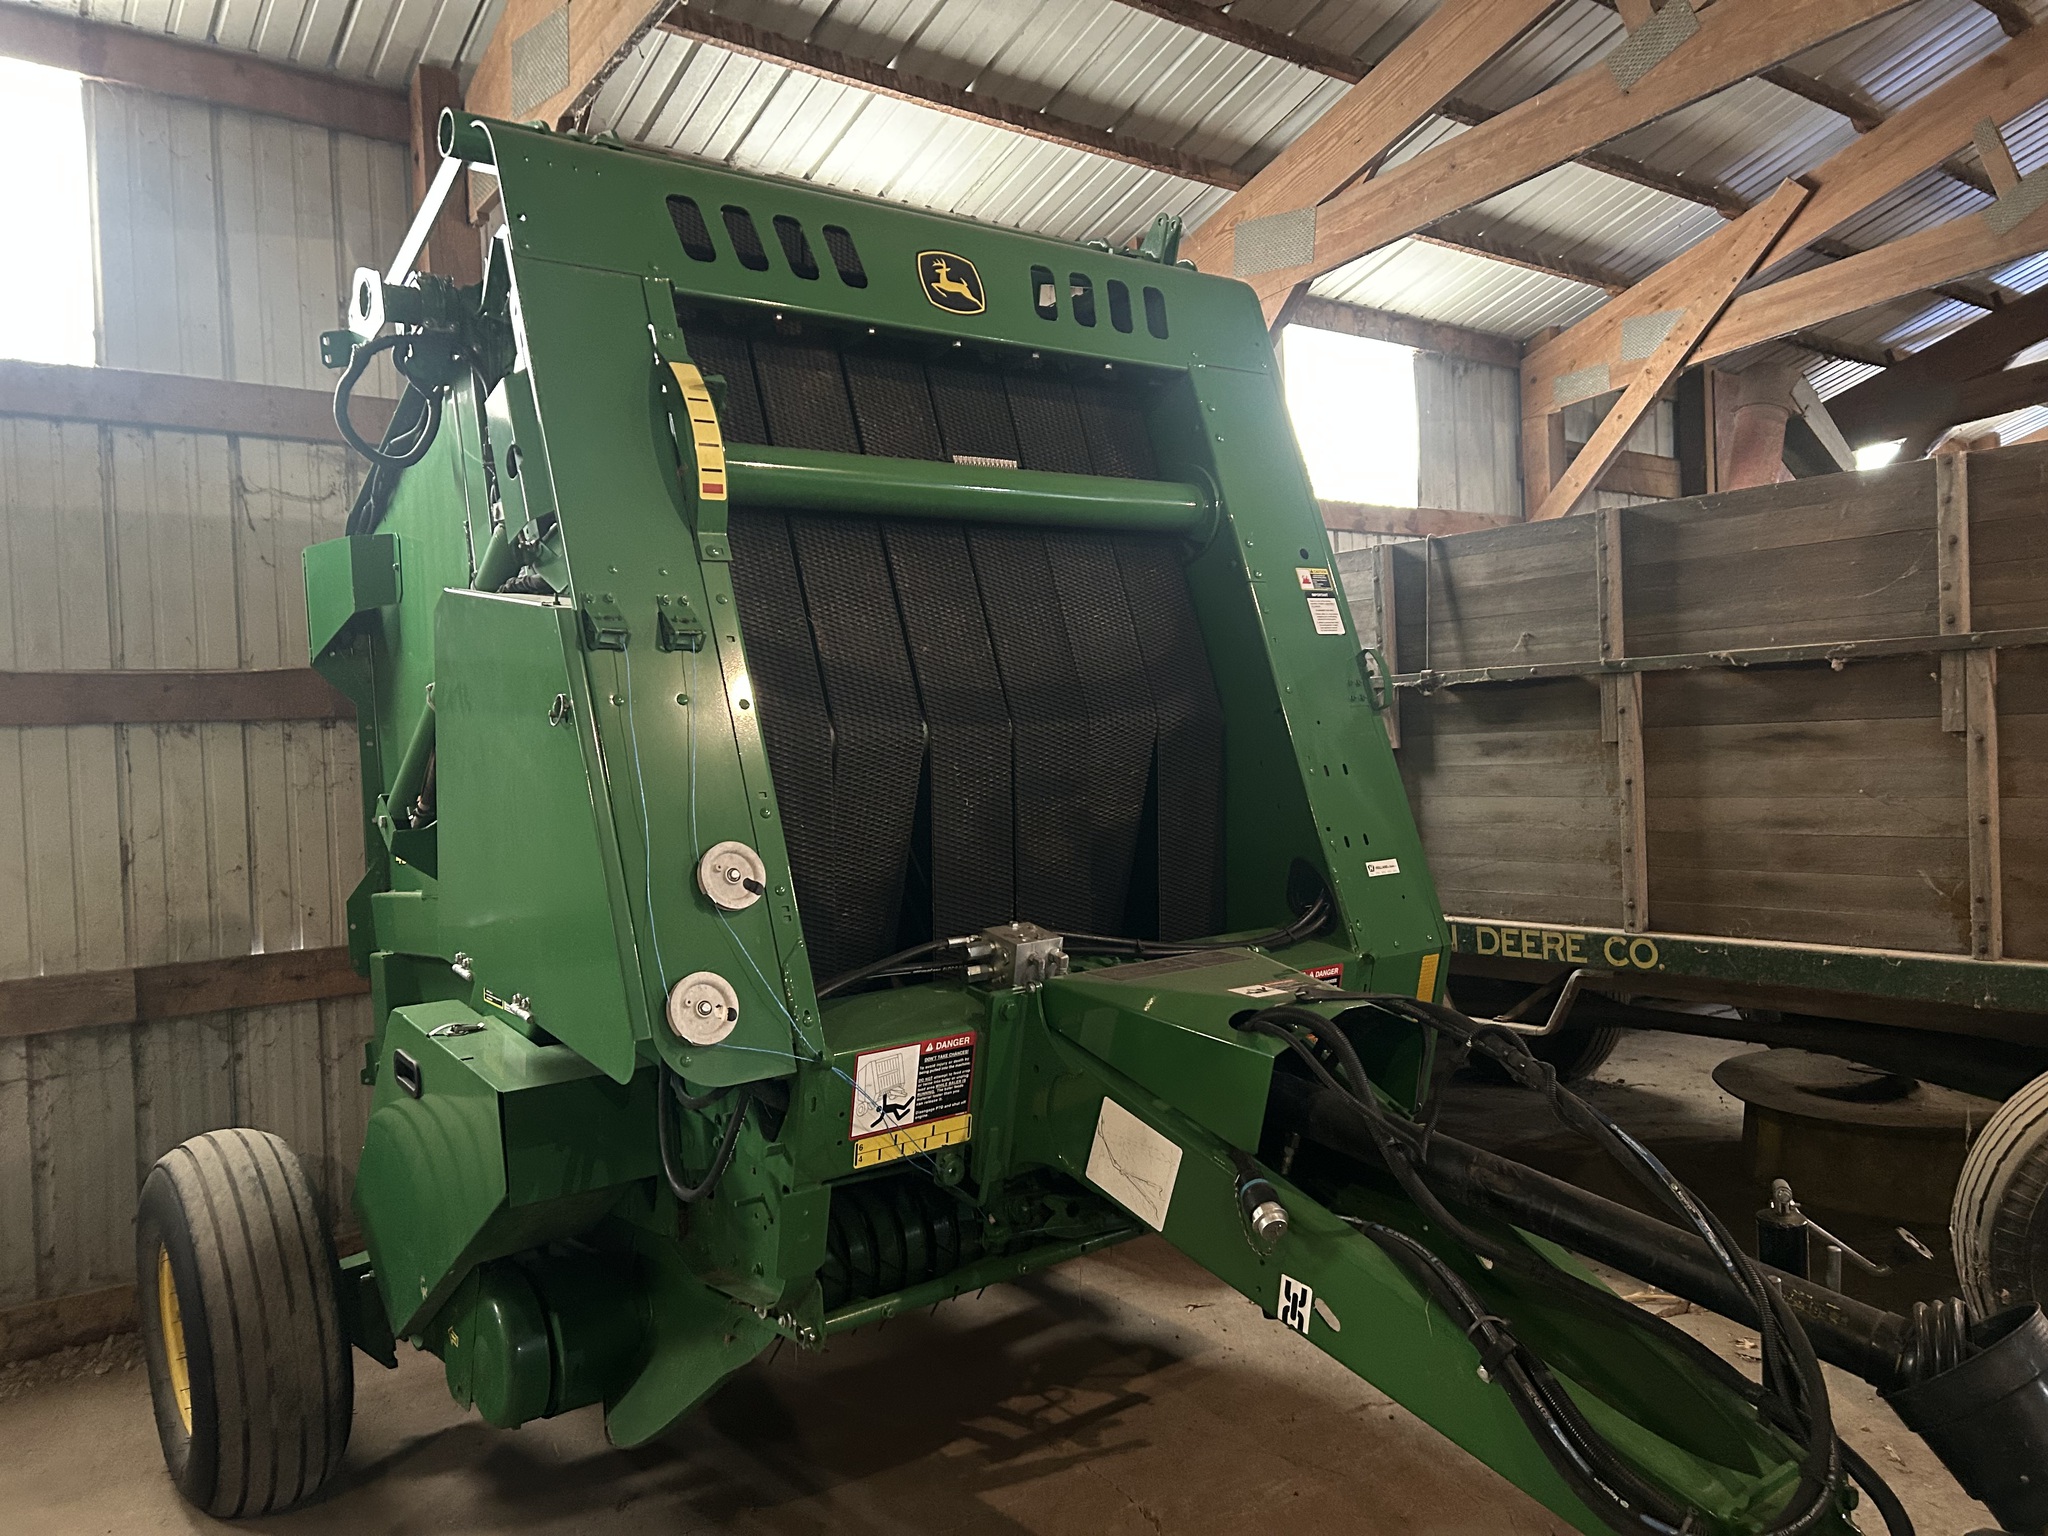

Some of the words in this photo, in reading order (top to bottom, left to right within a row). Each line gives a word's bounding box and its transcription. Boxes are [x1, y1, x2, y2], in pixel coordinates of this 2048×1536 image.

[1476, 926, 1588, 964] DEERE
[1604, 936, 1665, 971] CO.
[1315, 968, 1339, 978] DANGER
[936, 1036, 970, 1050] DANGER
